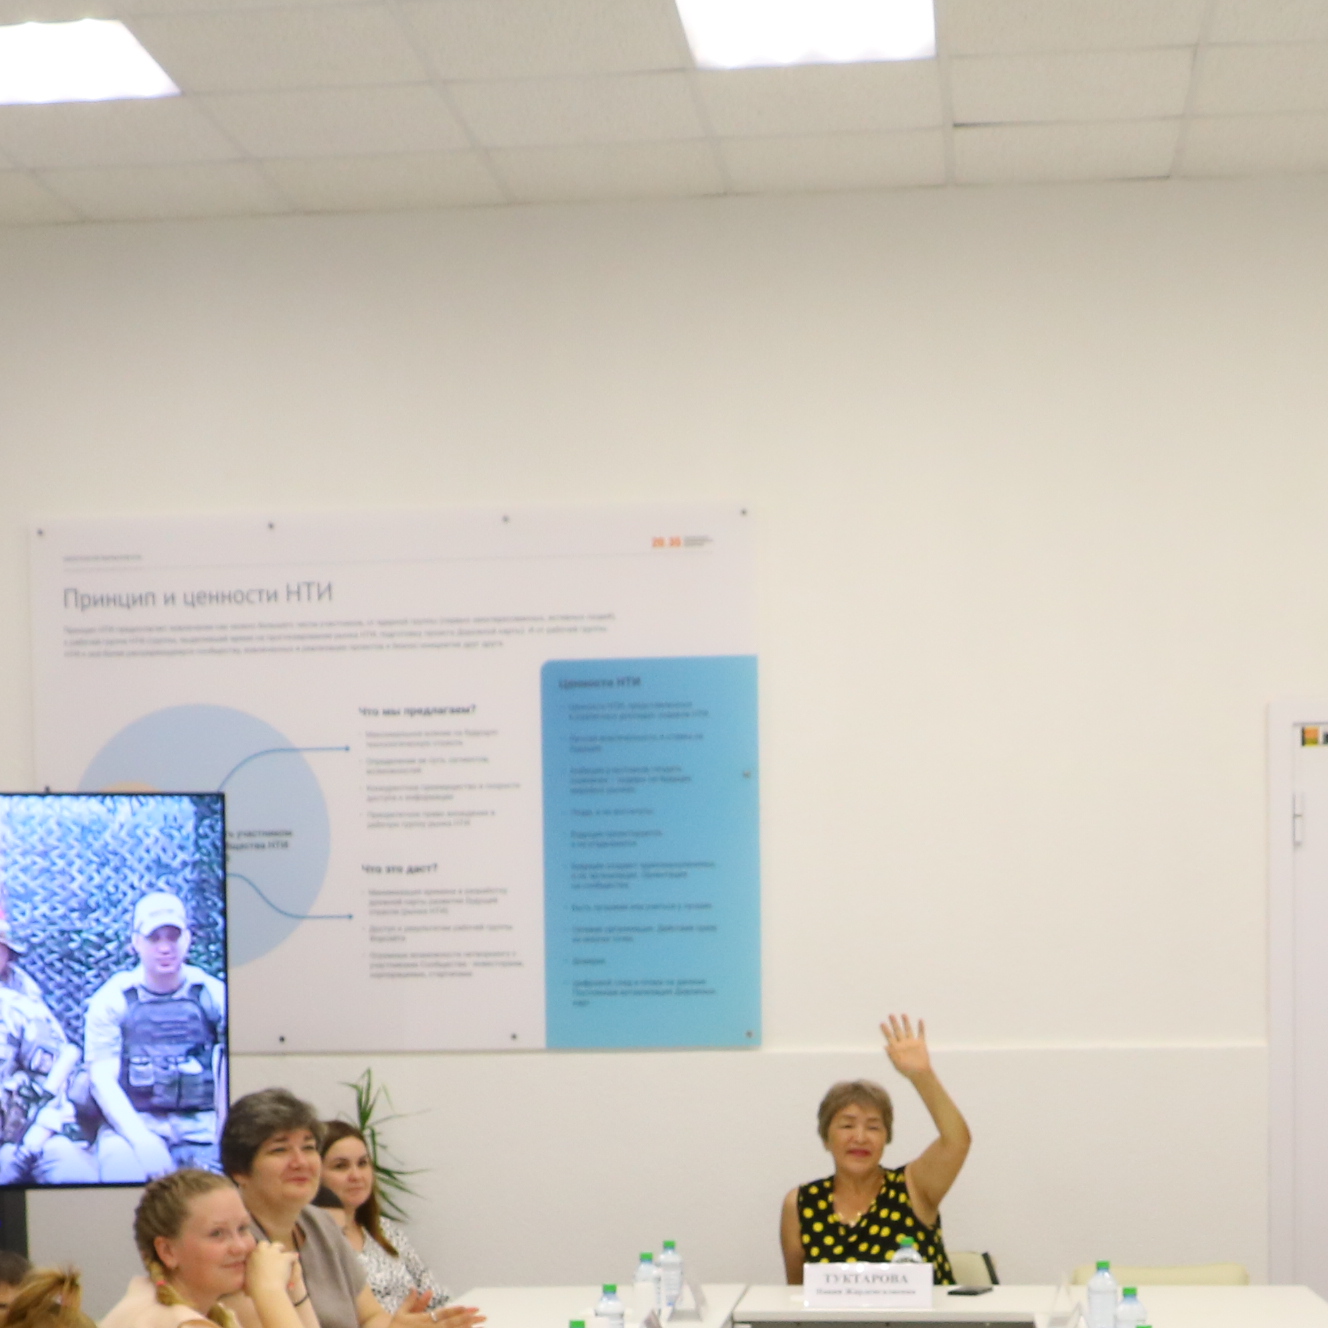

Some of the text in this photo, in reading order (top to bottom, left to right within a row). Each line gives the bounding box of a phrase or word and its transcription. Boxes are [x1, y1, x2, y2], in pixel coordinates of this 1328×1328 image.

[63, 582, 333, 611] Принцип и ценности НТИ
[359, 704, 477, 717] Что мы предлагаем?
[361, 863, 438, 875] Что это даст?
[825, 1274, 908, 1284] ТУКТАРОВА
